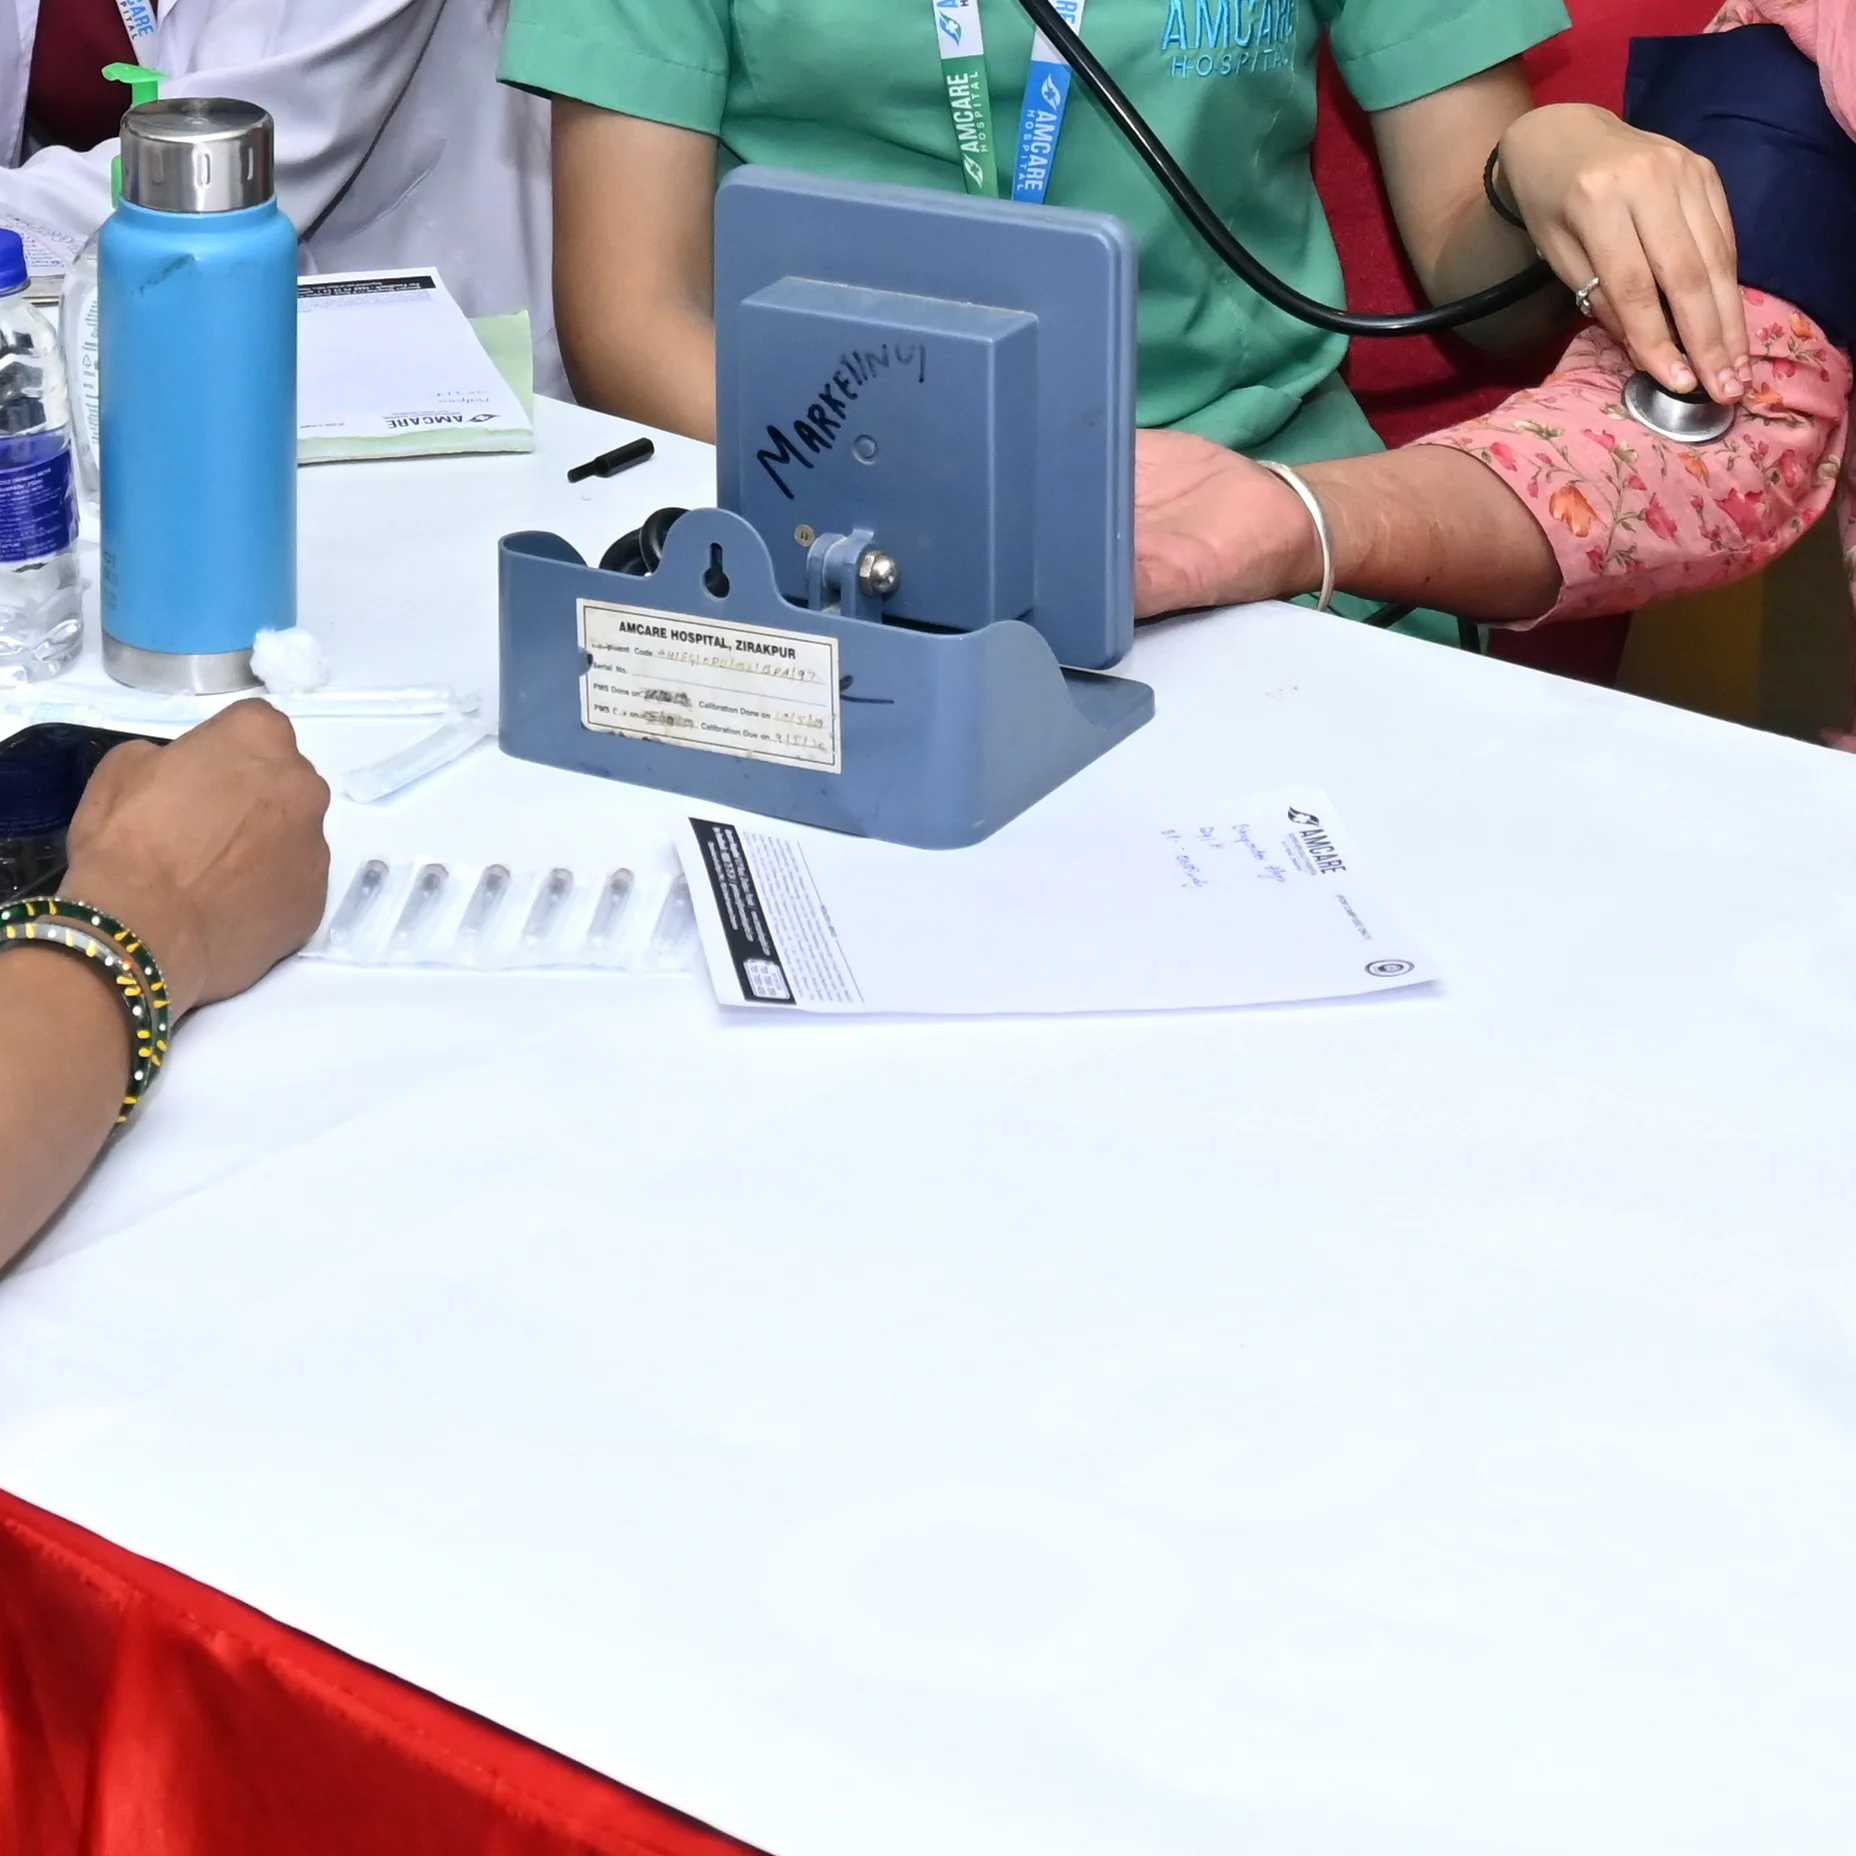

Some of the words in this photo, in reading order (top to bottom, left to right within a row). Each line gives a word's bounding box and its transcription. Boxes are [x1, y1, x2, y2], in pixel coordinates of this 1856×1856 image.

[947, 72, 980, 154] AMCARE
[970, 71, 989, 153] HOSPITAL
[1016, 108, 1036, 192] HOSPITAL
[1024, 109, 1058, 192] AMCARE
[387, 415, 463, 429] AMCARE
[619, 621, 667, 639] AMCARE
[670, 628, 733, 651] HOSPITAL,
[735, 639, 796, 660] ZIRAKPUR
[698, 700, 739, 715] Calibration
[740, 706, 760, 718] Done
[700, 721, 741, 737] Calibration
[1299, 828, 1347, 875] AMCARE
